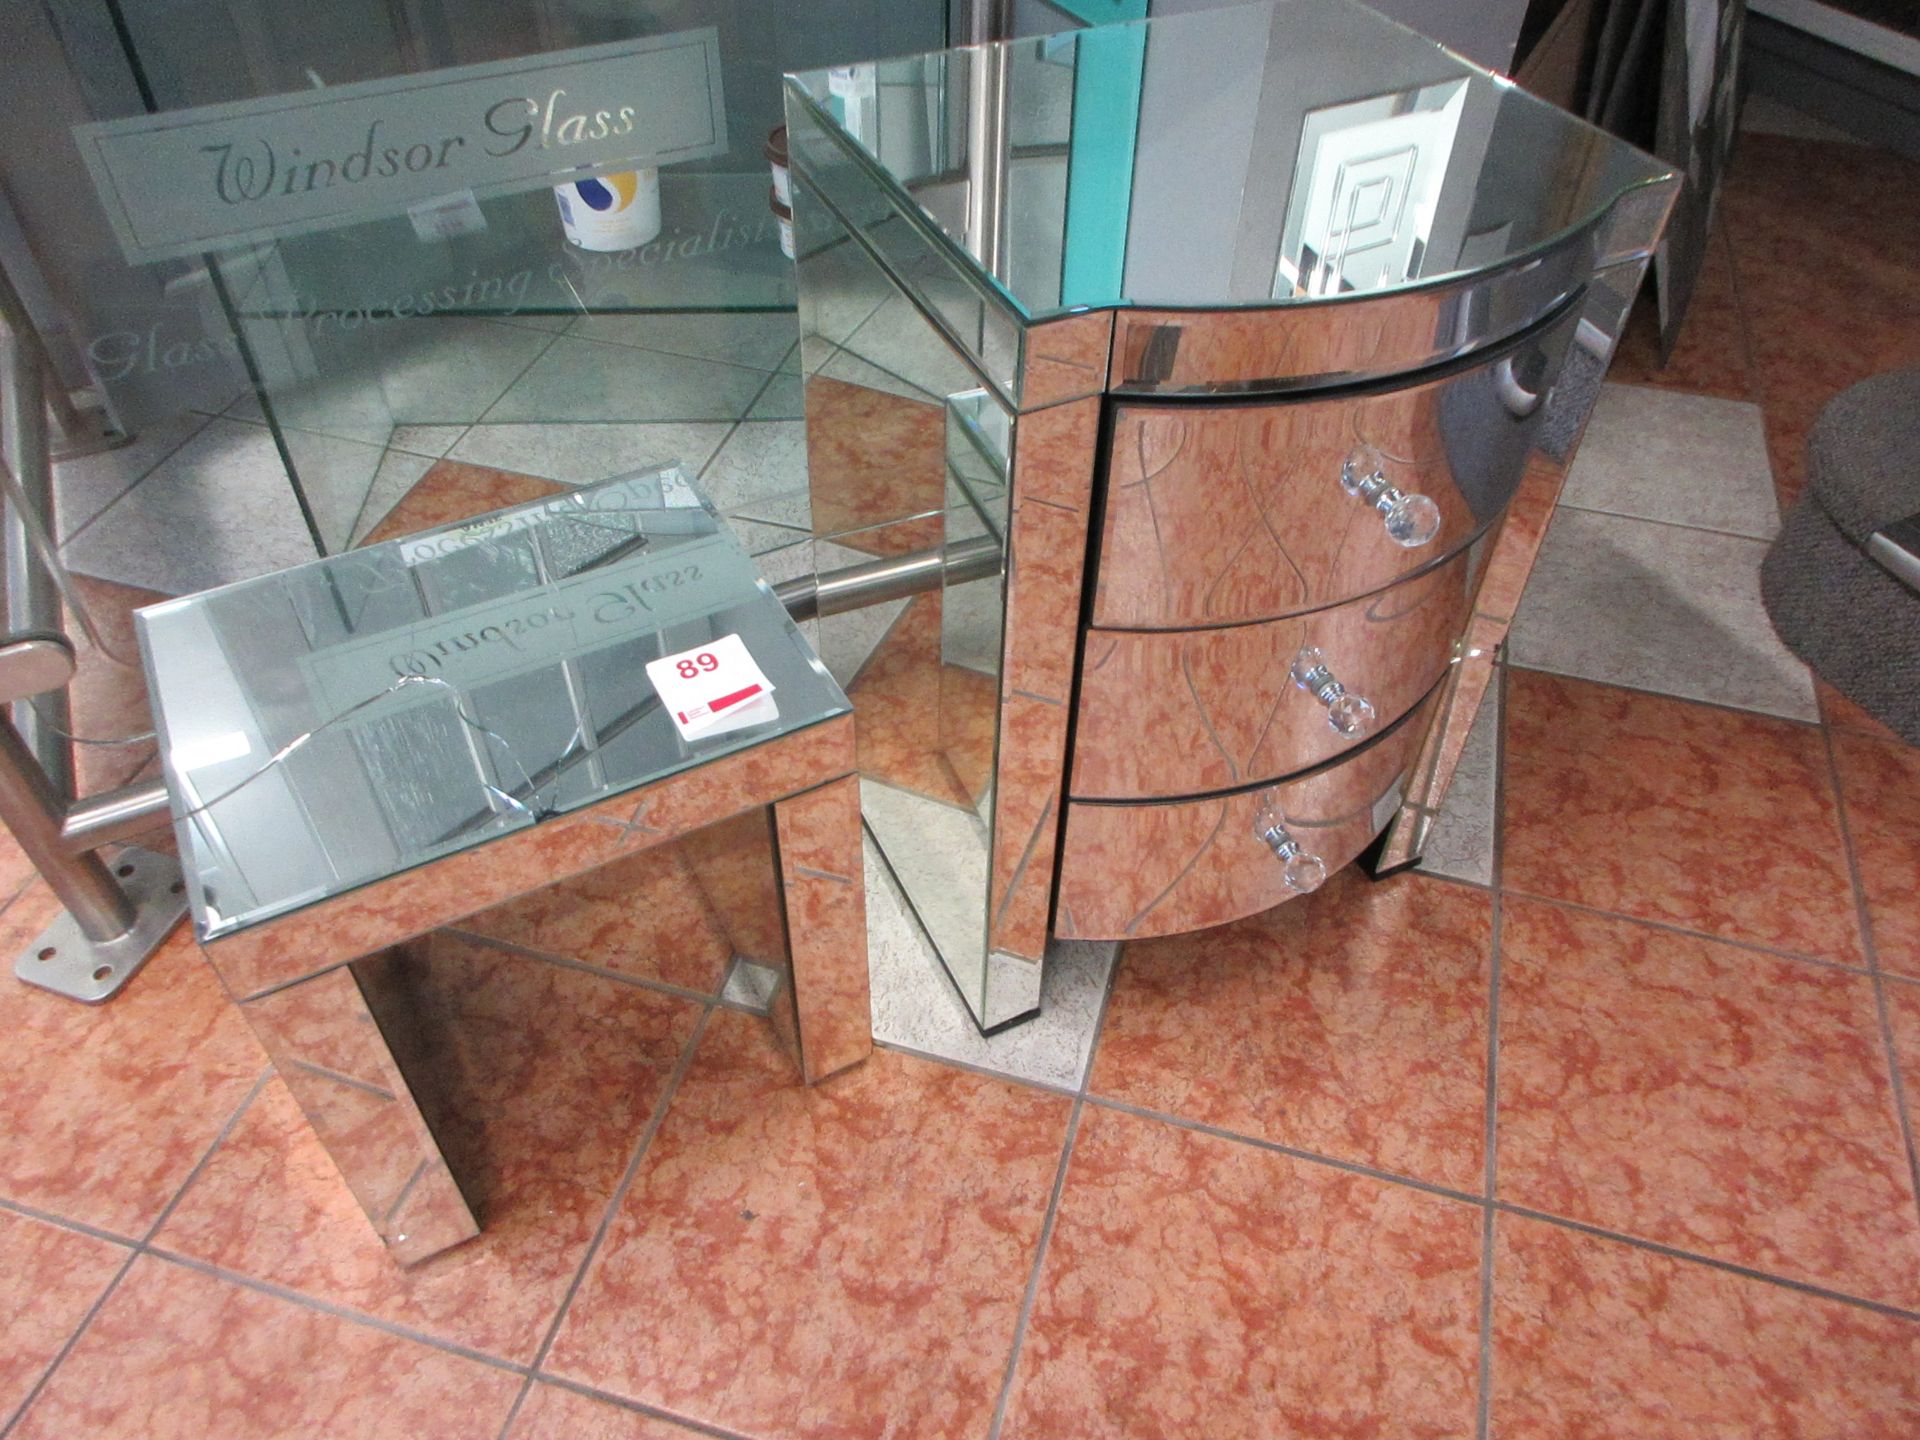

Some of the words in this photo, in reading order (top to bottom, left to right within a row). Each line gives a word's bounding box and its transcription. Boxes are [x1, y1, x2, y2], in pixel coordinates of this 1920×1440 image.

[202, 119, 465, 204] Windsor
[483, 89, 636, 157] Glass
[676, 653, 719, 679] 89
